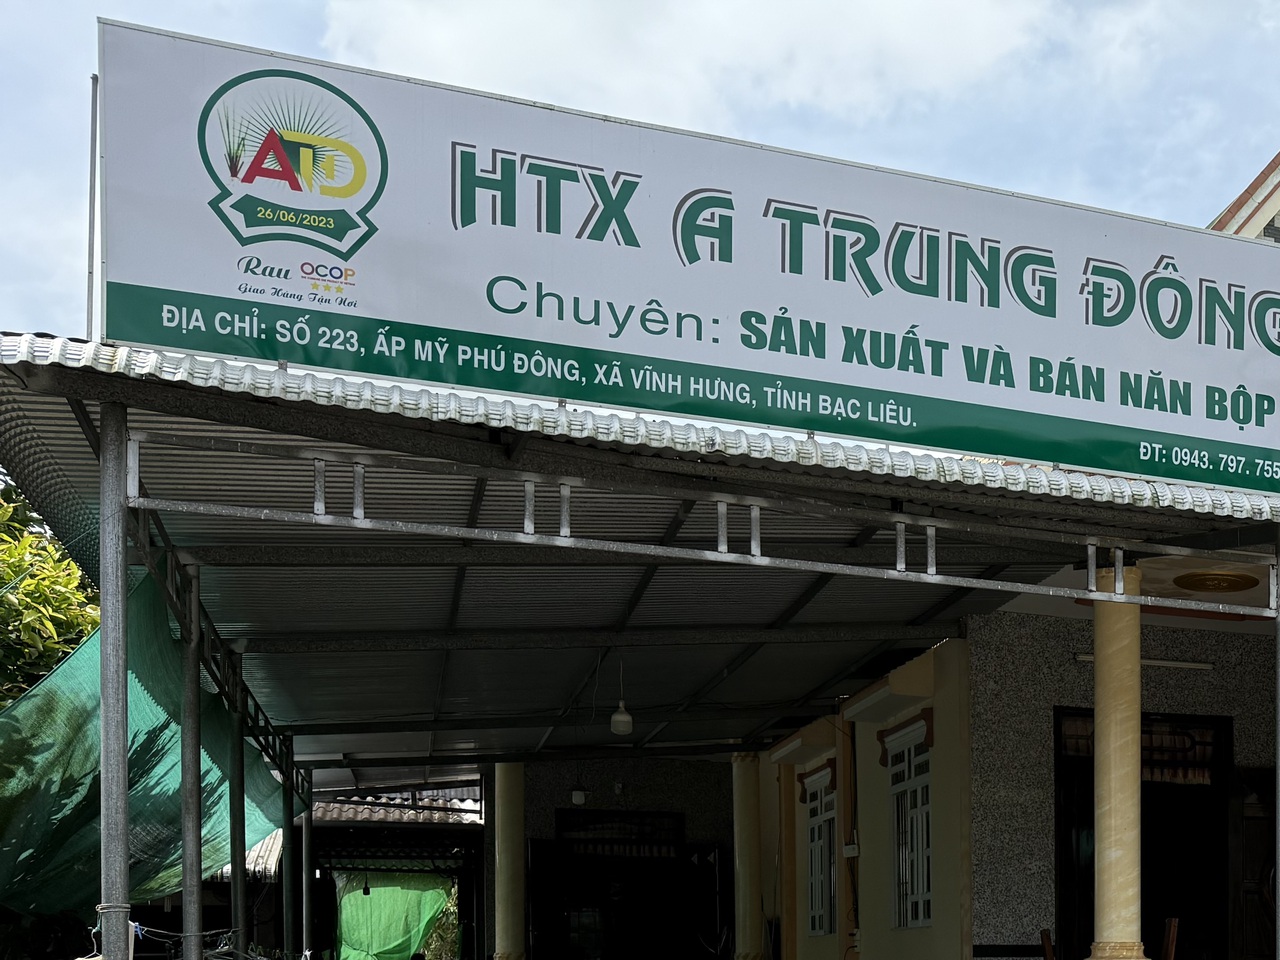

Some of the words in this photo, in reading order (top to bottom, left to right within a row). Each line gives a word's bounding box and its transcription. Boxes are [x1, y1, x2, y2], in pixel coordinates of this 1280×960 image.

[256, 206, 335, 229] 26/06/2023
[451, 140, 643, 249] HTX
[671, 187, 736, 268] A
[762, 198, 1058, 319] TRUNG
[236, 255, 293, 280] Rau
[300, 261, 356, 281] OCOP
[237, 282, 266, 294] Giao
[161, 304, 206, 334] ĐỊA
[214, 307, 267, 340] CHỈ:
[275, 314, 311, 345] SỐ
[318, 326, 365, 356] 223,
[373, 325, 406, 358] ẤP
[414, 337, 449, 364] MỸ
[457, 344, 506, 372] PHÚ
[513, 349, 586, 386] ĐÔNG,
[593, 361, 624, 388] XÃ
[630, 365, 682, 395] VĨNH
[689, 376, 757, 409] HƯNG,
[763, 380, 811, 412] TỈNH
[818, 394, 861, 421] BẠC
[867, 399, 918, 427] LIÊU.
[485, 275, 720, 344] Chuyên:
[739, 306, 827, 360] SẢN
[841, 324, 950, 378] XUẤT
[961, 344, 1016, 389] VÀ
[1029, 356, 1105, 403] BÁN
[1119, 369, 1192, 417] NĂN
[1205, 383, 1276, 431] BỘP
[1139, 441, 1166, 463] ĐT:
[1171, 446, 1213, 470] 0943.
[1218, 453, 1250, 475] 797.
